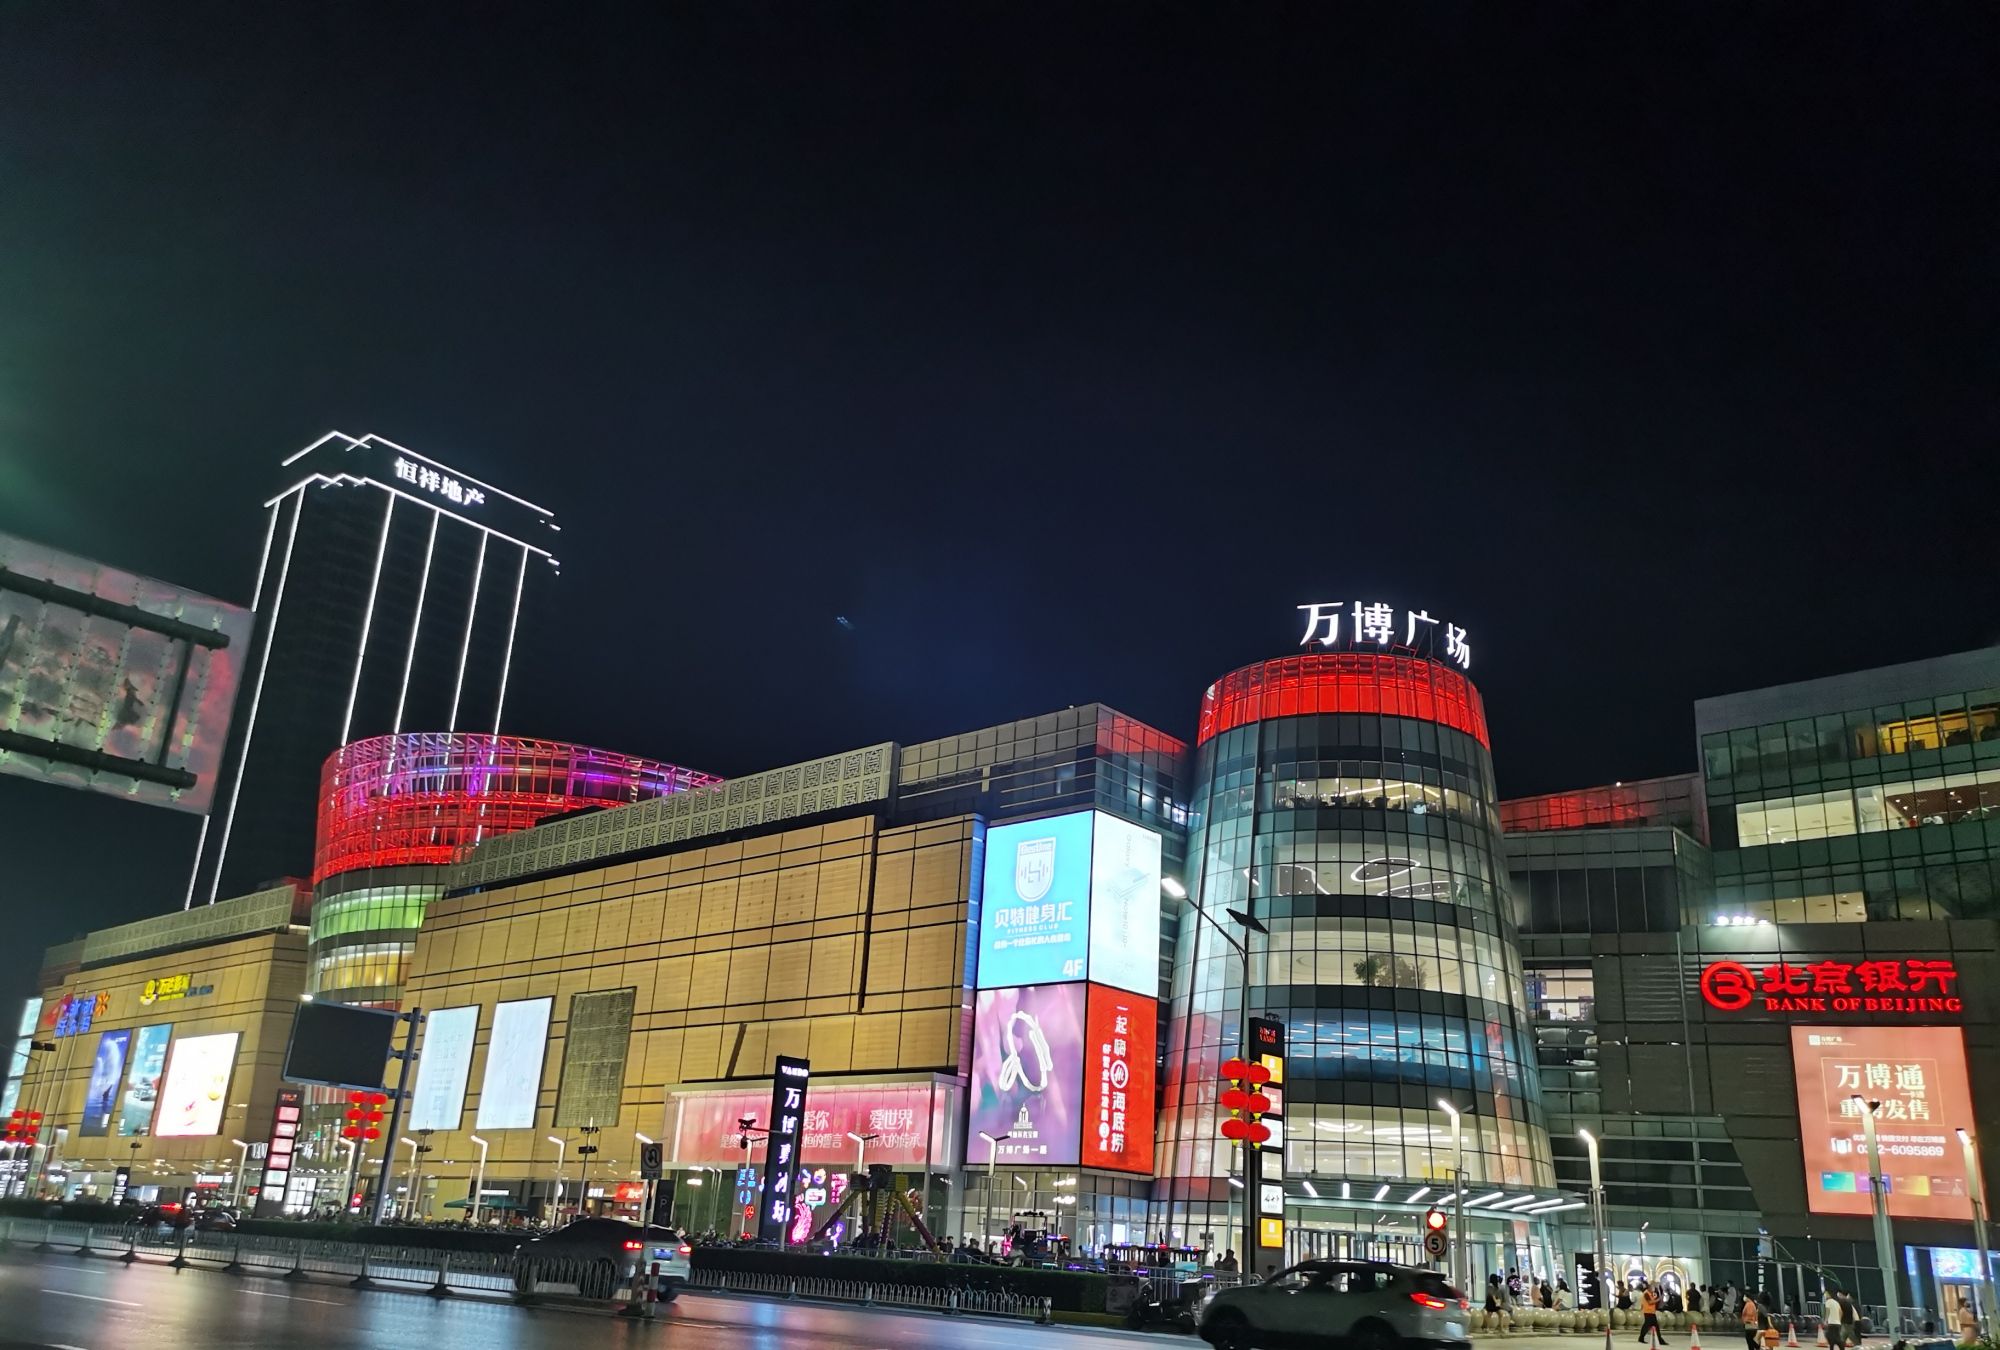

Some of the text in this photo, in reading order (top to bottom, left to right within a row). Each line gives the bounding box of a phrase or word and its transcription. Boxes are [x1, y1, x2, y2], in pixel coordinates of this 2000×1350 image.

[395, 456, 485, 505] 恒祥地产
[1297, 600, 1470, 669] 万博广场
[994, 901, 1073, 928] 贝特健身汇
[1062, 958, 1085, 977] 4F
[1762, 960, 1957, 994] 北京银行
[1766, 998, 1962, 1013] BANK OF BEIJING
[1834, 1063, 1926, 1090] 万博通
[869, 1109, 913, 1131] 爱世界
[1111, 1091, 1127, 1153] 海底捞
[800, 1134, 844, 1149] 恒的誓言
[1431, 1237, 1439, 1249] 5
